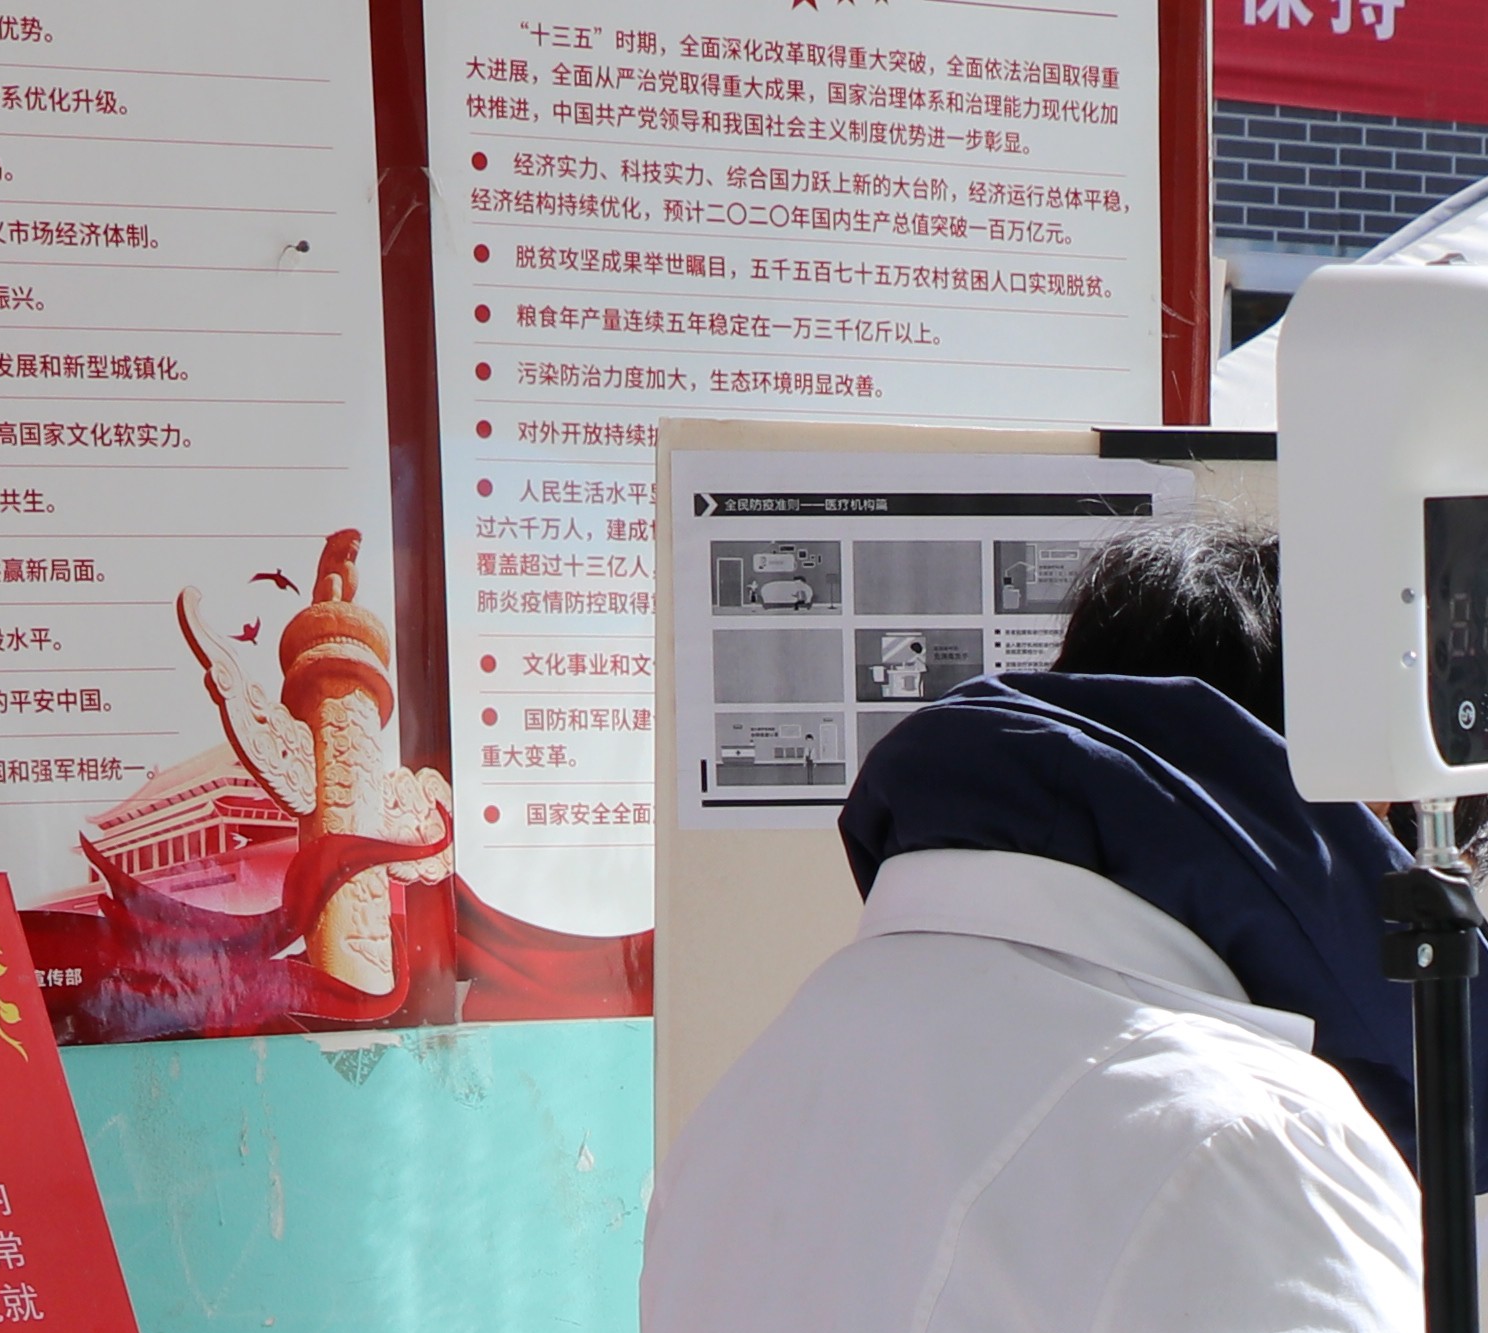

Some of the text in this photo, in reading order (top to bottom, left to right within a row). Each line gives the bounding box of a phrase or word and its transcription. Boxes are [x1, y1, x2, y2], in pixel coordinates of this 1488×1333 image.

[476, 516, 656, 542] 过六千万人，建成
[477, 590, 656, 615] 肺炎疫情防控取得
[523, 653, 655, 676] 文化事业和文
[524, 708, 655, 731] 国防和军队建
[481, 745, 576, 768] 重大变革。
[526, 802, 655, 826] 国家安全全面
